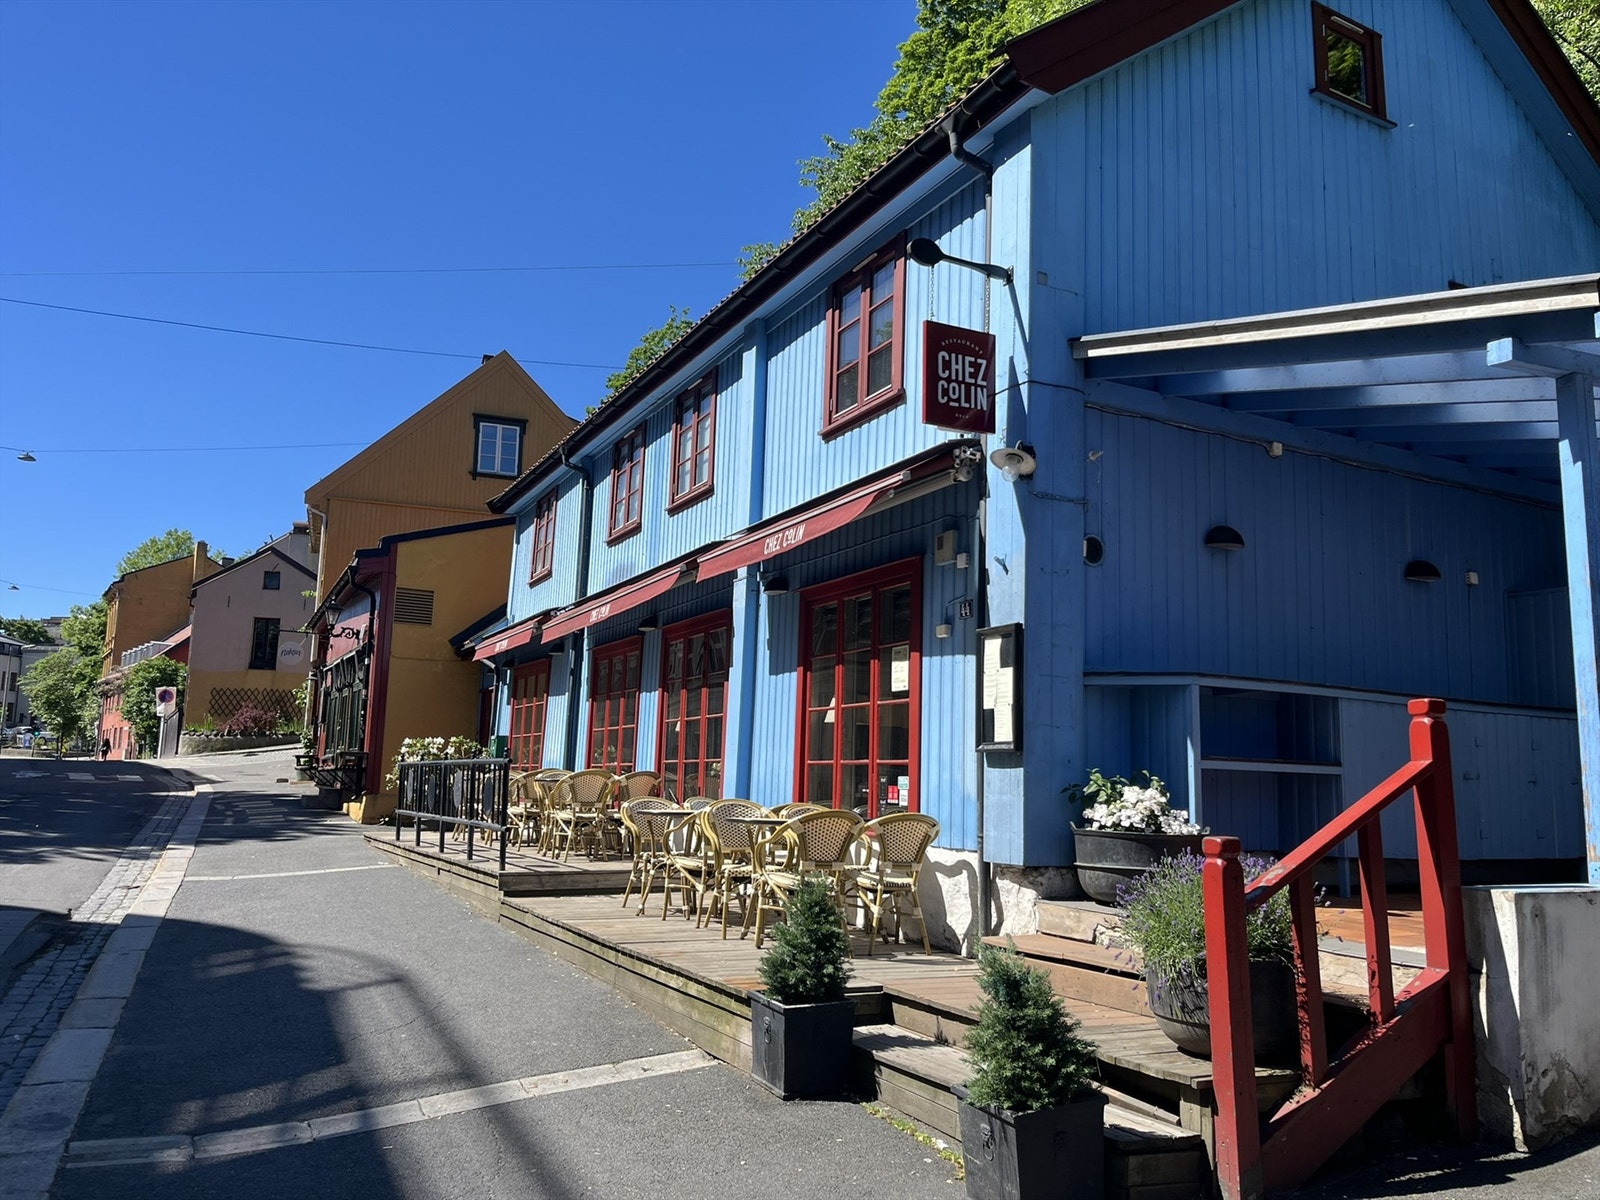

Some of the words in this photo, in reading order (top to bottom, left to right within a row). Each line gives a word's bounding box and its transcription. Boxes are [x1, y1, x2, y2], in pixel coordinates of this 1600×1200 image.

[937, 350, 987, 386] CHEZ
[937, 379, 987, 411] COLIN
[764, 532, 783, 555] CHEZ
[783, 523, 806, 548] COLIN
